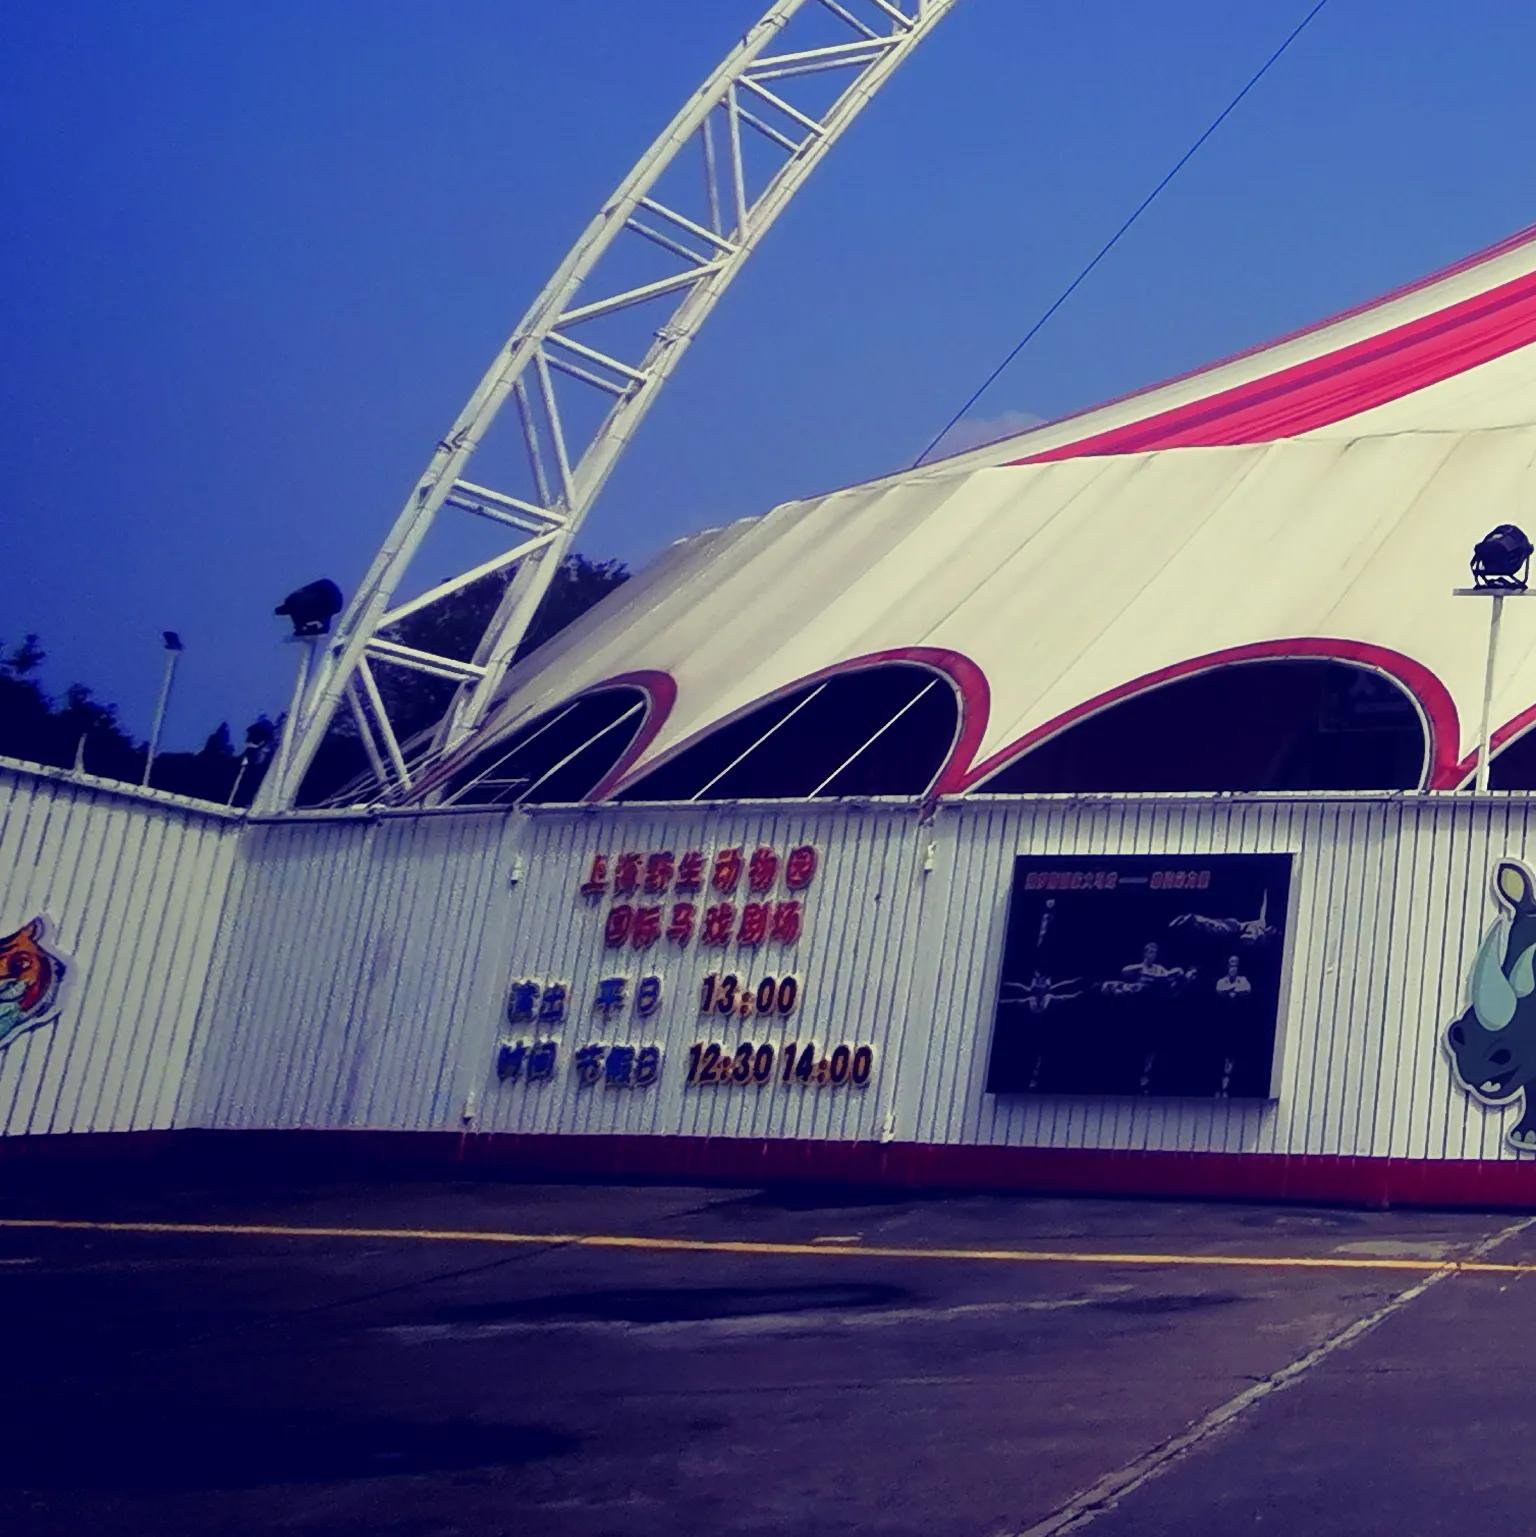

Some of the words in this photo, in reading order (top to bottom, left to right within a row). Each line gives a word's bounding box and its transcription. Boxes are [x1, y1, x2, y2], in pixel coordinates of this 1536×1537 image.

[604, 900, 800, 949] 国际马戏剧场
[702, 972, 798, 1019] 13:00
[686, 1041, 775, 1086] 12:30
[781, 1041, 874, 1087] 14:00
